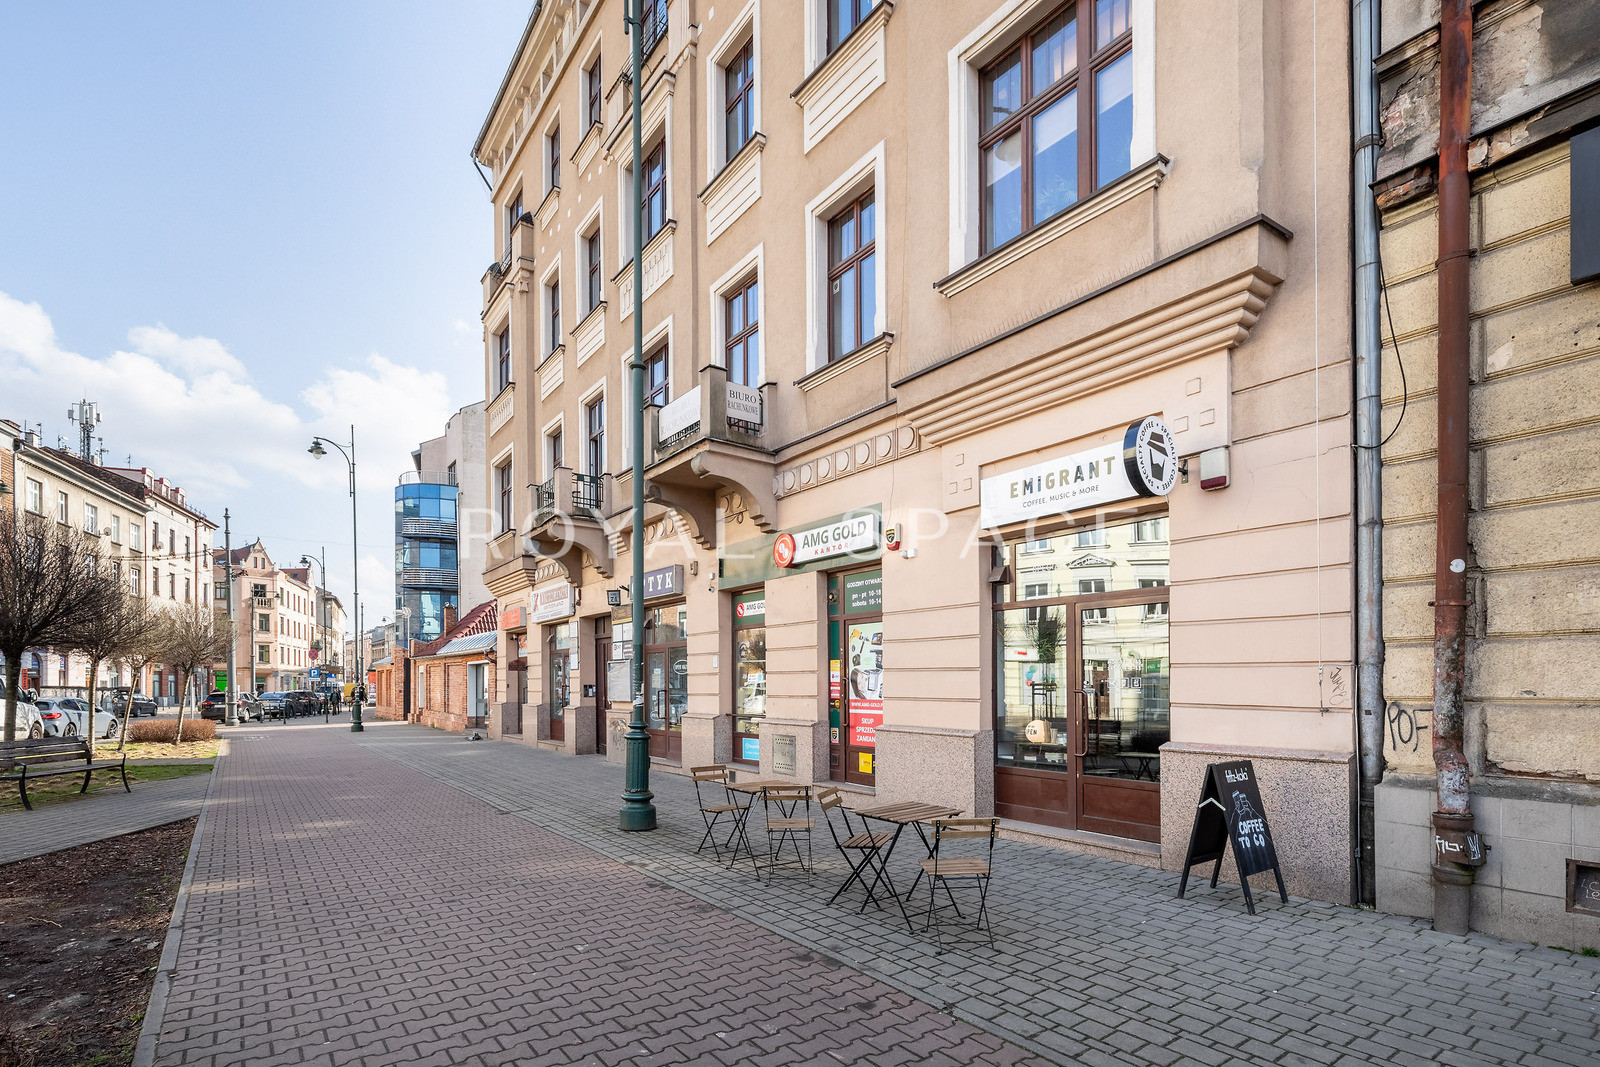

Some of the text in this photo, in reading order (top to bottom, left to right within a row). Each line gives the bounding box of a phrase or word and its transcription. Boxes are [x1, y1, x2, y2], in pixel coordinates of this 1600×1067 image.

[729, 389, 757, 404] BIURO
[727, 399, 759, 416] RACHUNKOWE
[1137, 420, 1155, 487] SPECIALTY COFFEE
[1160, 425, 1178, 491] SPECIALTY COFFEE
[1022, 484, 1100, 509] COFFEE, MUSIC & MORE
[802, 520, 867, 550] AMG GOLD
[814, 542, 850, 556] KANTOR
[746, 603, 757, 611] AMG
[311, 669, 318, 677] P
[861, 717, 875, 725] SKUP
[1238, 818, 1265, 836] COFFEE
[1238, 833, 1266, 849] TO GO
